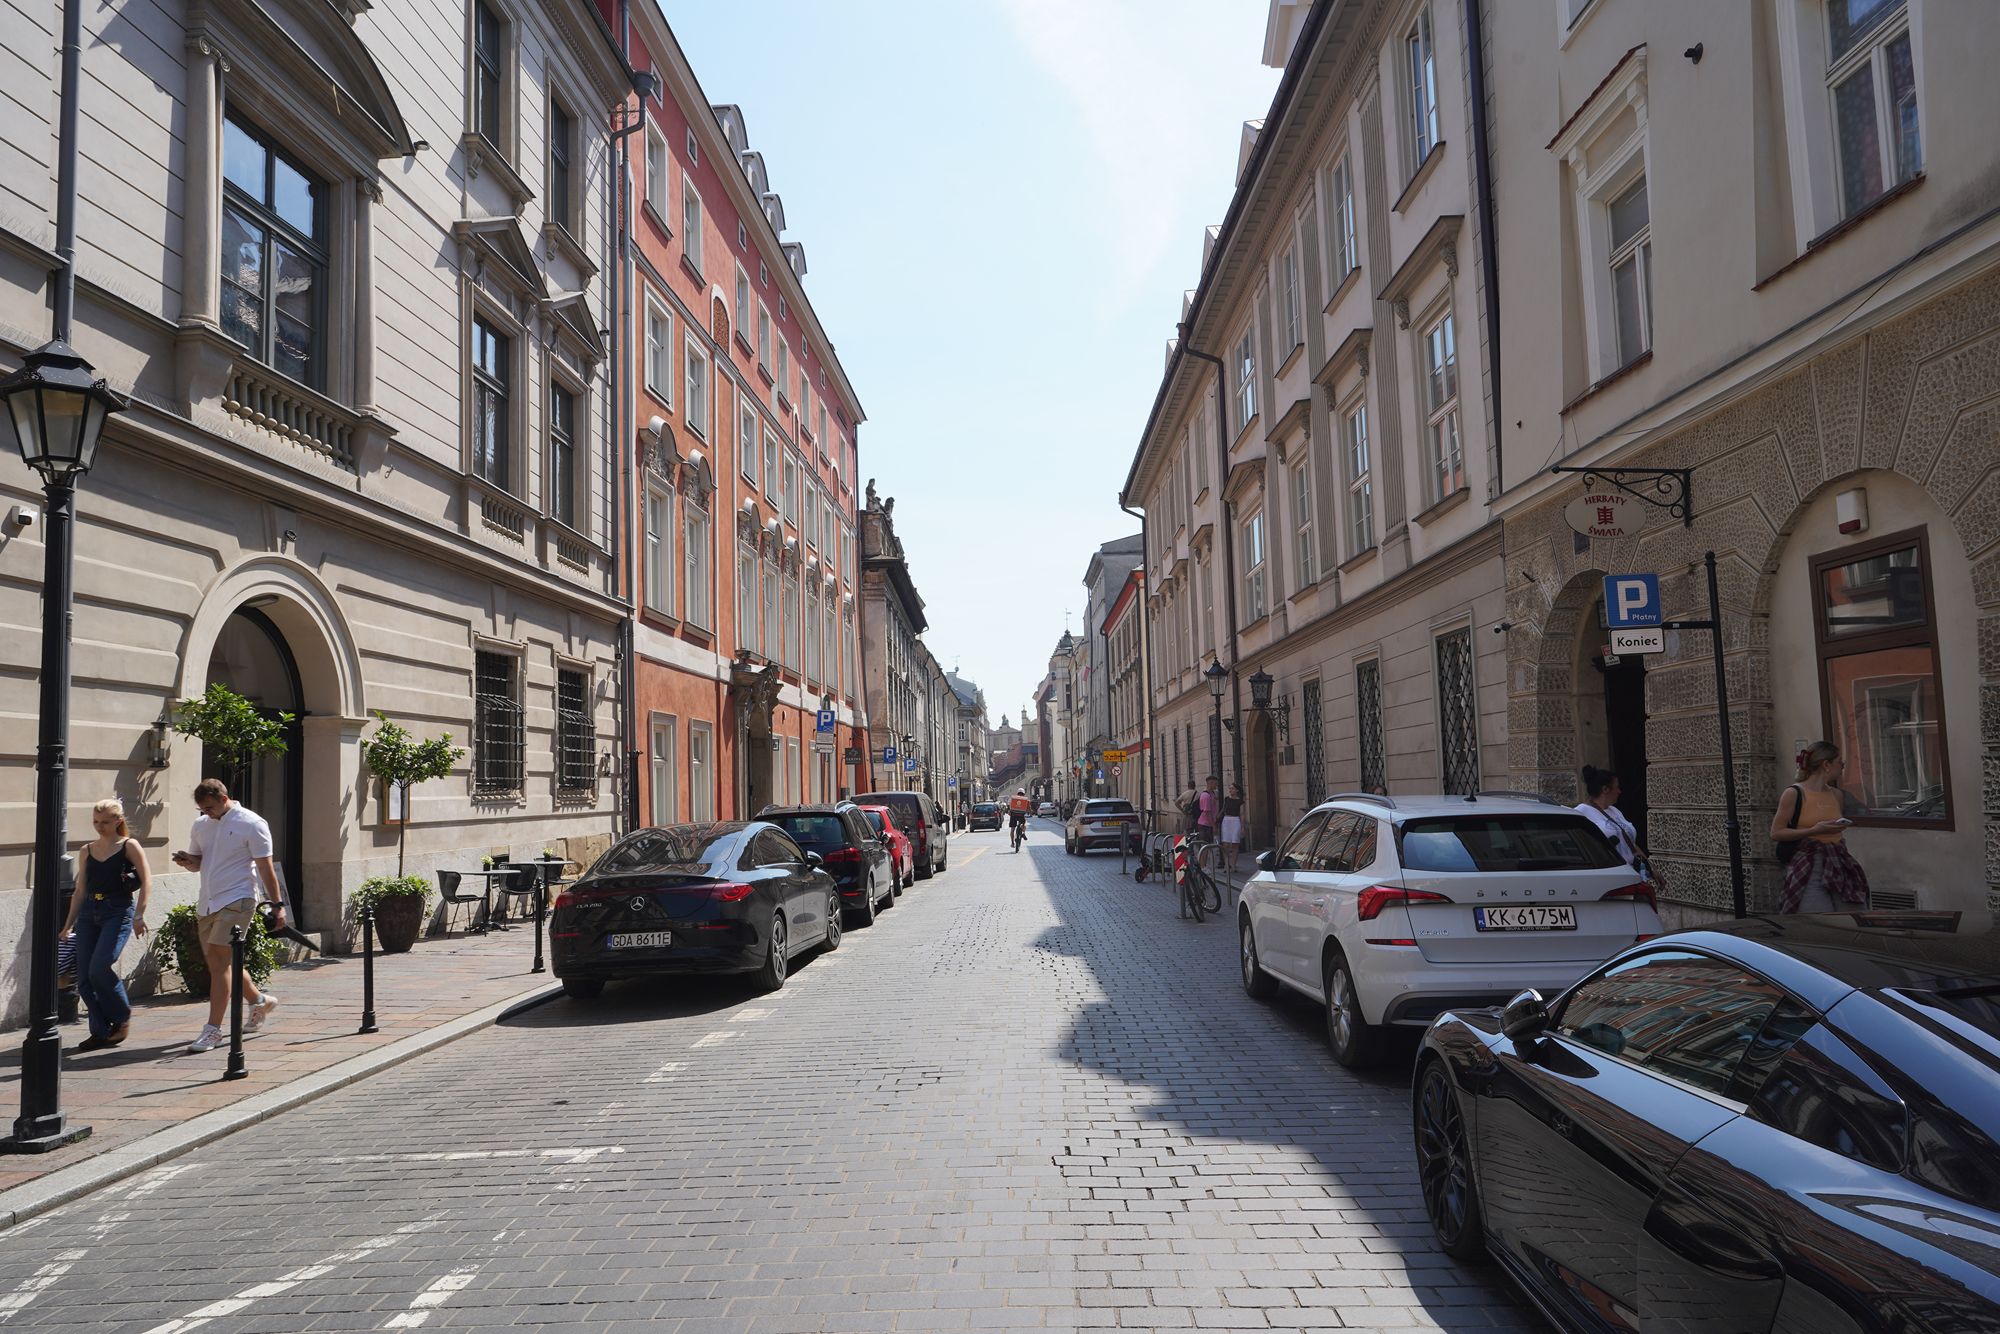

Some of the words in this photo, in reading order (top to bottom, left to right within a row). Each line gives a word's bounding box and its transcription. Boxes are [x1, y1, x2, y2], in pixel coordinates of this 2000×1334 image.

[1584, 495, 1628, 506] HERBATY
[1597, 506, 1615, 525] 東
[1588, 525, 1625, 538] ŚWIATA
[1616, 580, 1649, 621] P
[1632, 613, 1657, 622] Płatny
[1617, 635, 1659, 648] Koniec
[821, 711, 832, 727] P
[887, 748, 894, 759] P
[906, 759, 914, 770] P
[1487, 909, 1511, 926] KK
[1517, 908, 1571, 925] 6175M
[612, 935, 633, 947] GDA
[636, 932, 670, 945] 8611E
